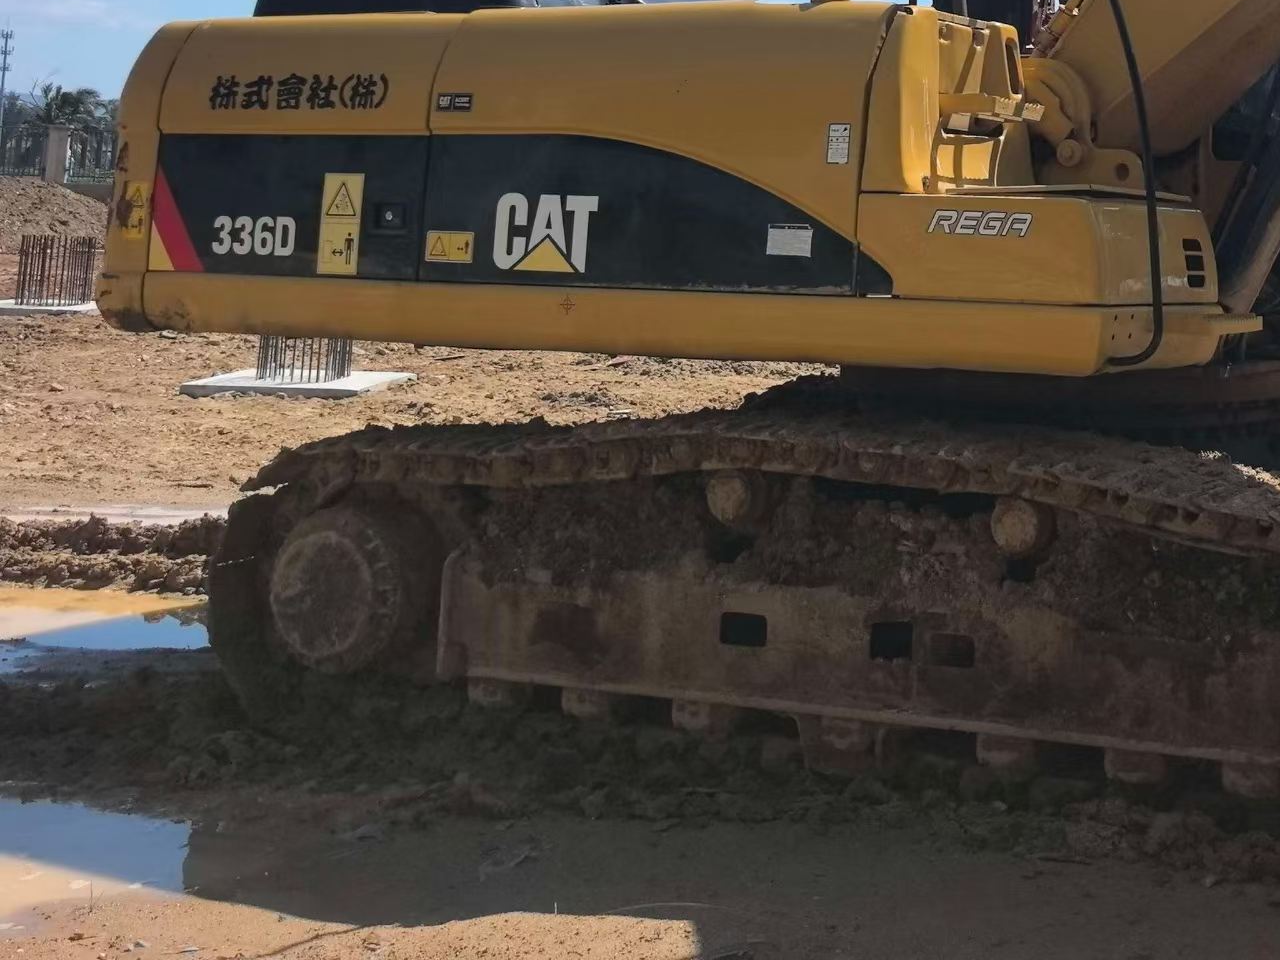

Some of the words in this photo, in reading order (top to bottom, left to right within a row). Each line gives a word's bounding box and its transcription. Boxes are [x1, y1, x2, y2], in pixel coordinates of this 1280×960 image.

[212, 215, 296, 256] 336D
[492, 193, 600, 274] CAT
[927, 209, 1033, 237] REGA
